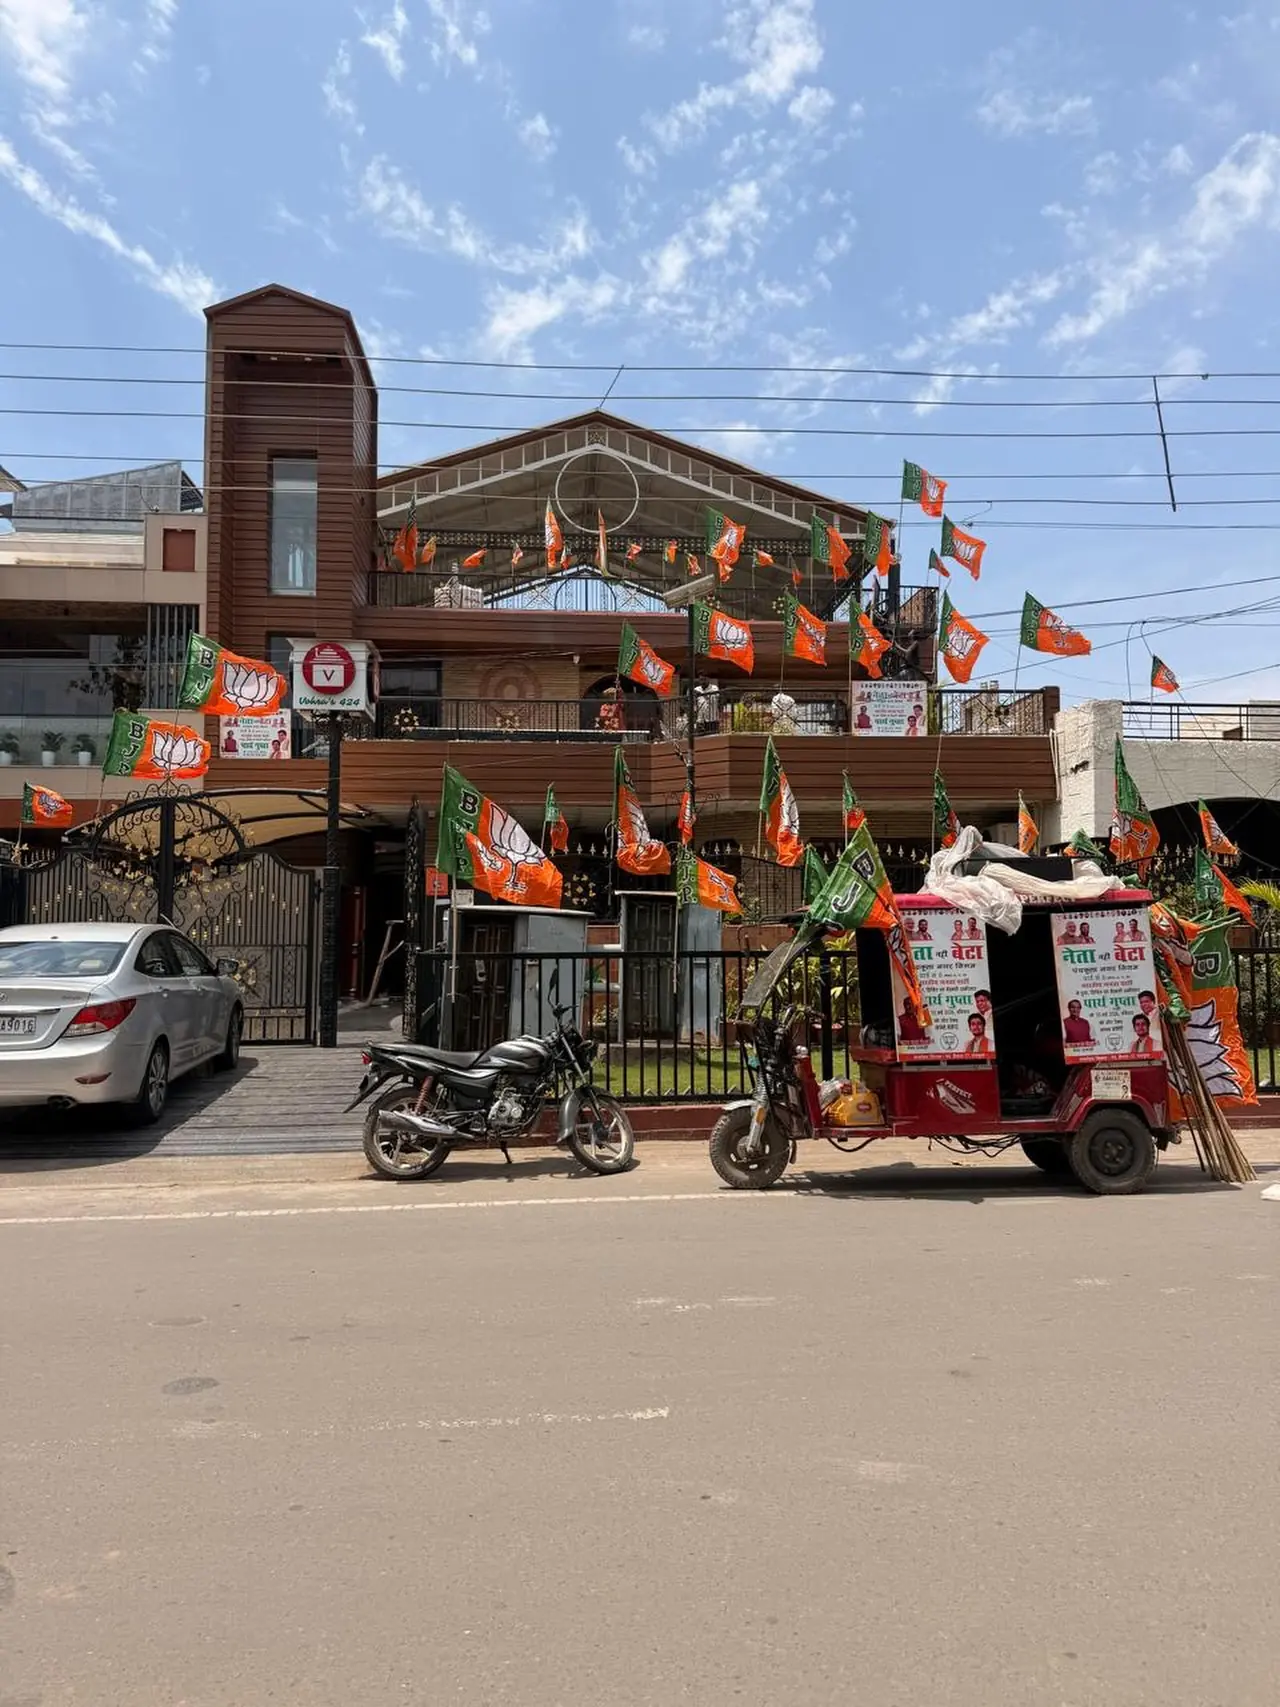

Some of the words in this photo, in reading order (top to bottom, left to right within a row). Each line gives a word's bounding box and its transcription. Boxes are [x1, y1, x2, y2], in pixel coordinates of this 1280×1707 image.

[322, 669, 335, 682] V
[340, 697, 360, 706] 424
[951, 942, 985, 961] बेटा
[1062, 947, 1097, 964] नेता
[1114, 944, 1146, 963] बेटा
